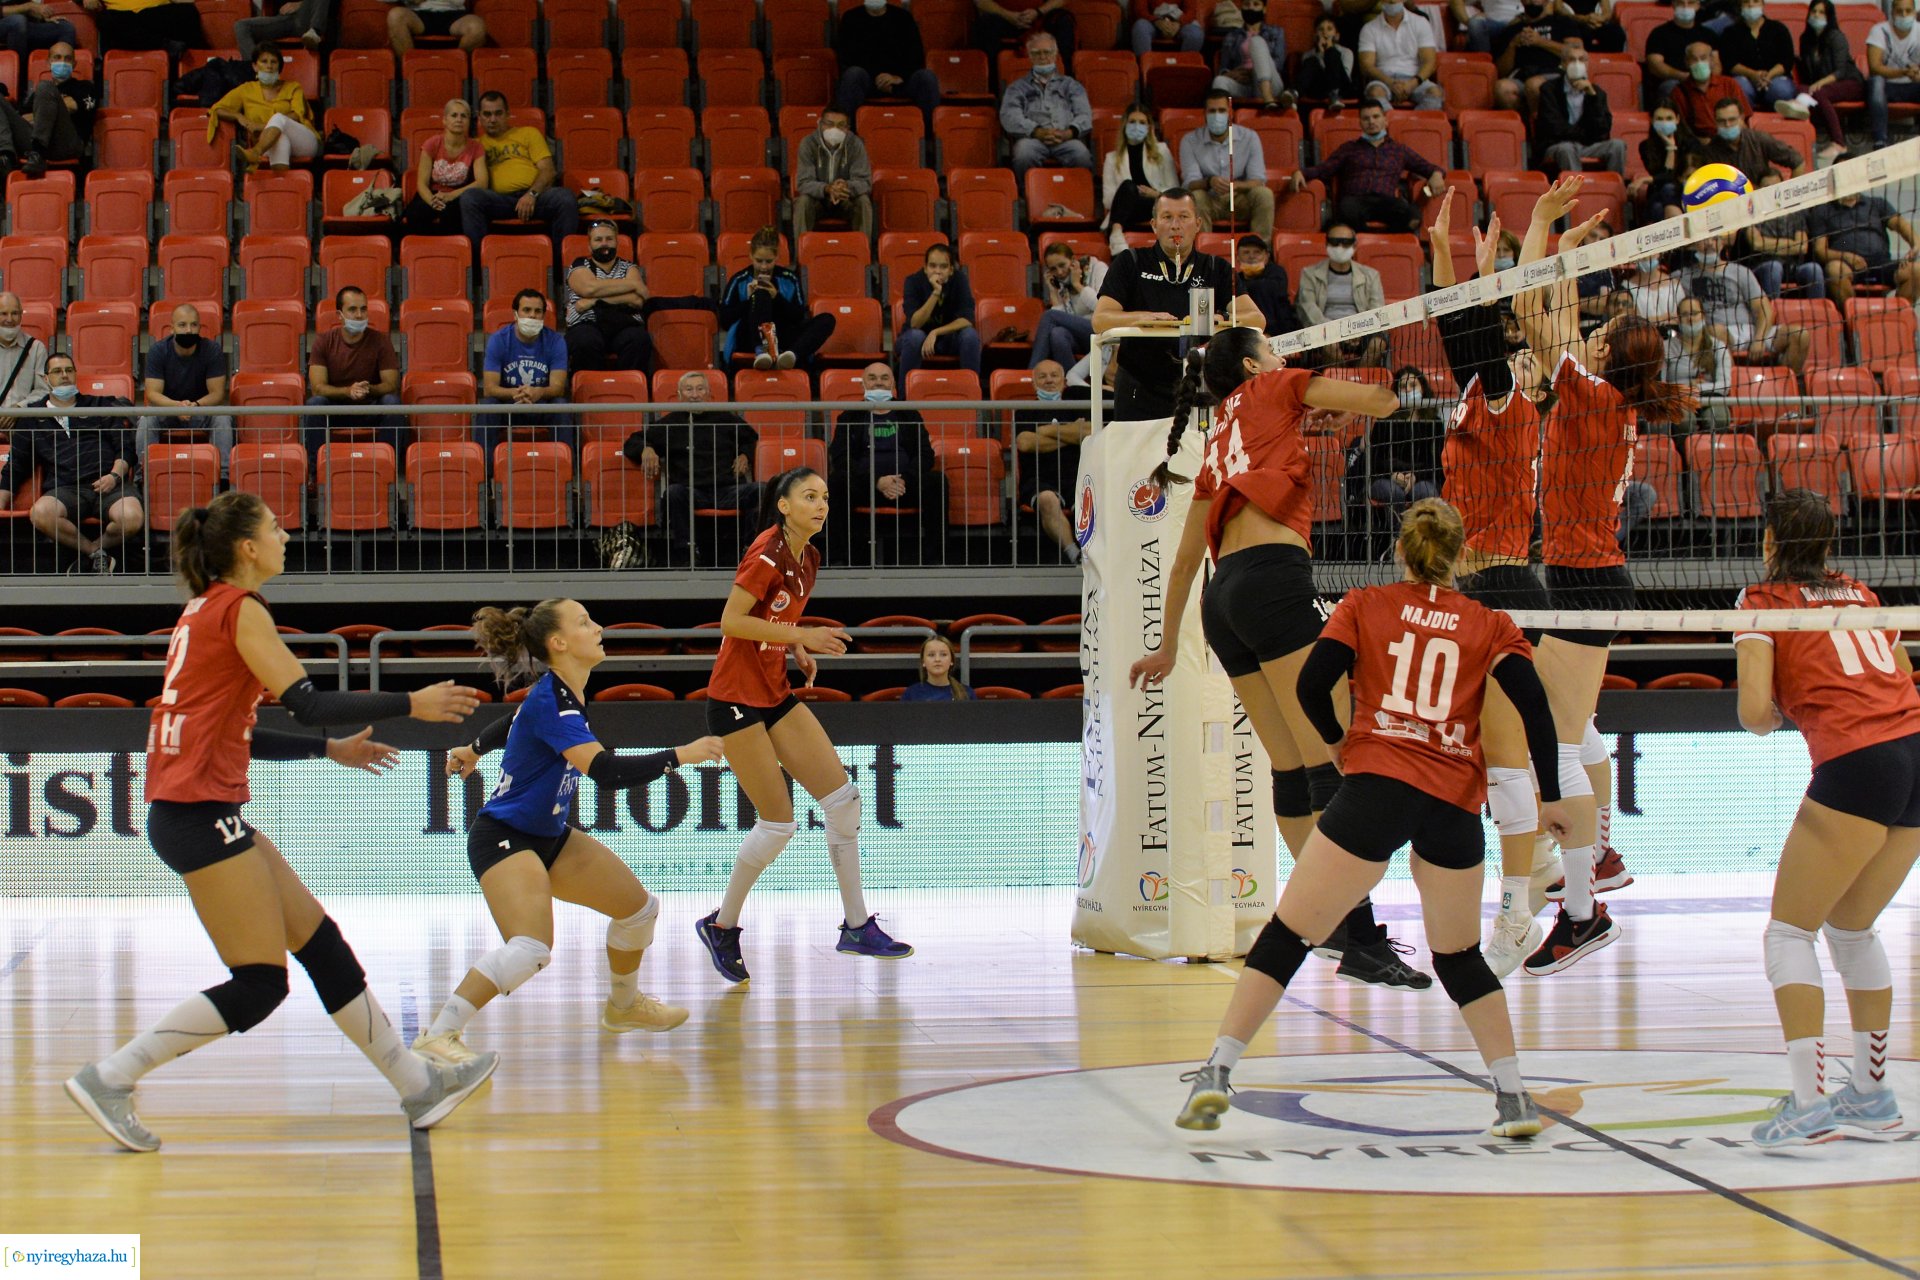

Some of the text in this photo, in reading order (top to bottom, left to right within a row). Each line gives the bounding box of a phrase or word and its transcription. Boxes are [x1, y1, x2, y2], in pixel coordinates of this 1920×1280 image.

[1400, 604, 1460, 631] NAJDIC
[1380, 631, 1460, 722] 10
[1137, 536, 1168, 853] FATUM-NYÍGYHÁZA
[729, 705, 745, 721] 1
[214, 815, 246, 845] 12
[1132, 904, 1168, 912] NYÍREGYH
[1232, 901, 1265, 909] EGYHÁZA
